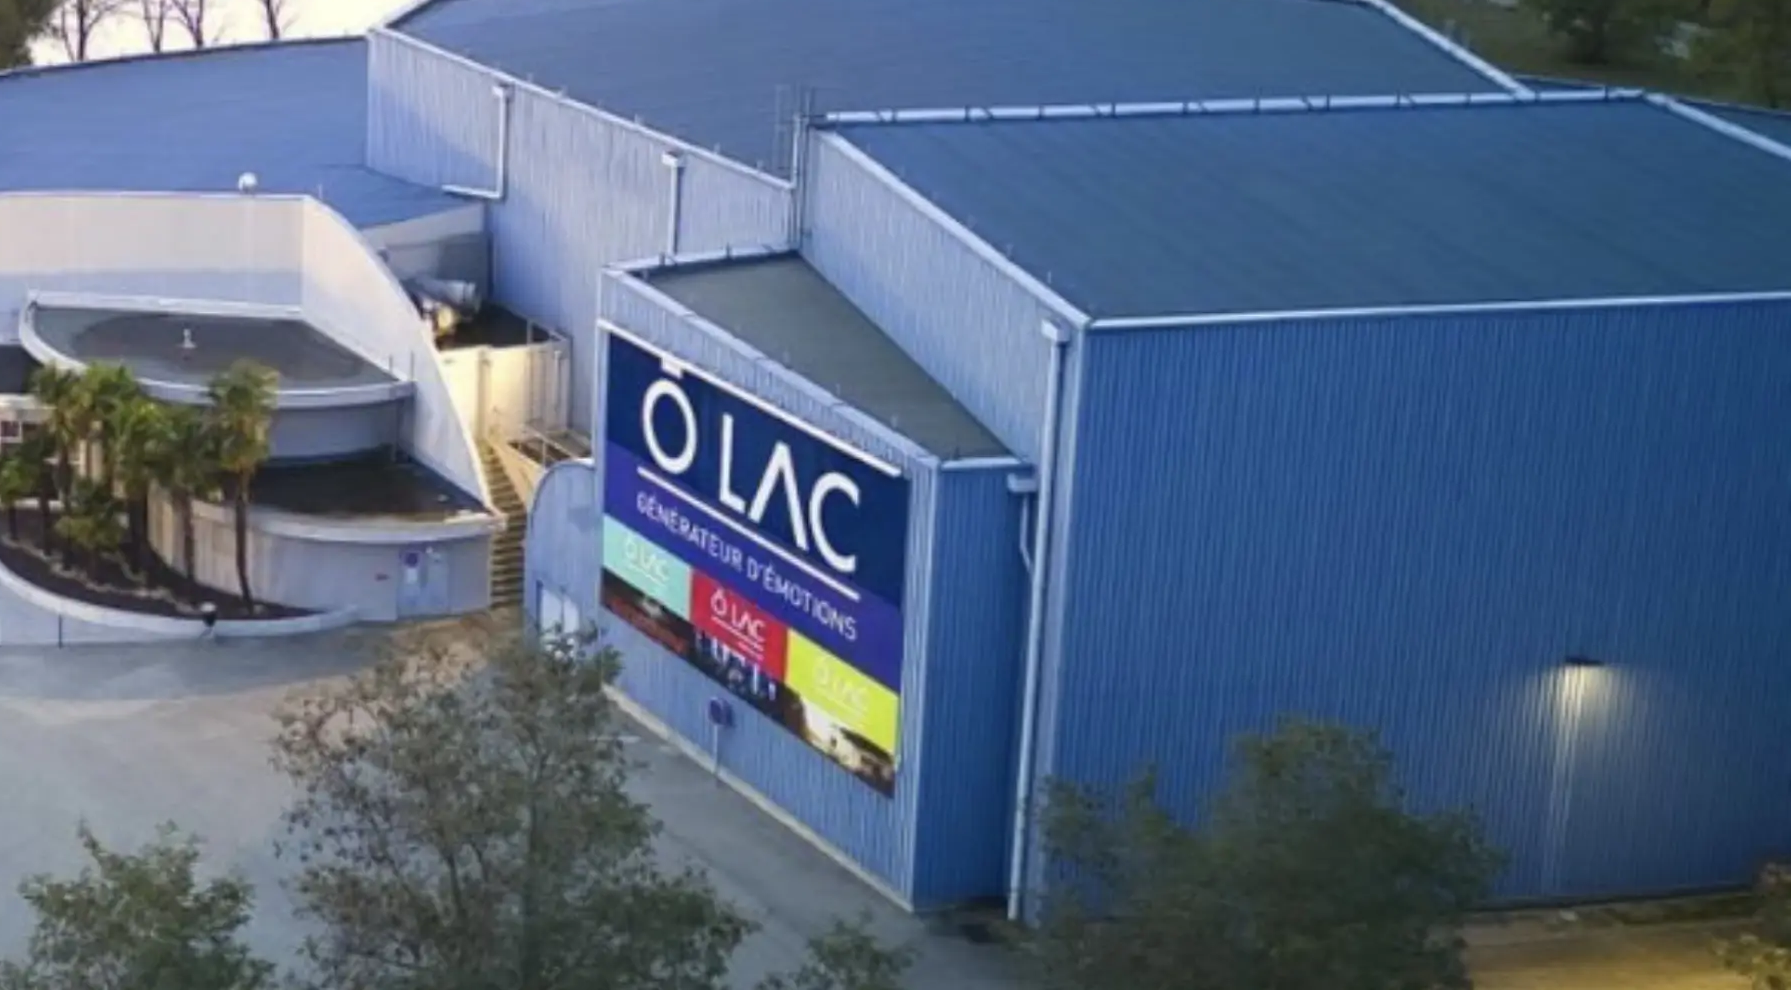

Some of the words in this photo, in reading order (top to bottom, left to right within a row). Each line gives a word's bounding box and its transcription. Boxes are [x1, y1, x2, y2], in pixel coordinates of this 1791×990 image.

[636, 491, 743, 572] GÉNÉRATEUR
[747, 556, 857, 642] D'ÉMOTIONS
[719, 413, 860, 573] LAC
[731, 603, 766, 642] LAC
